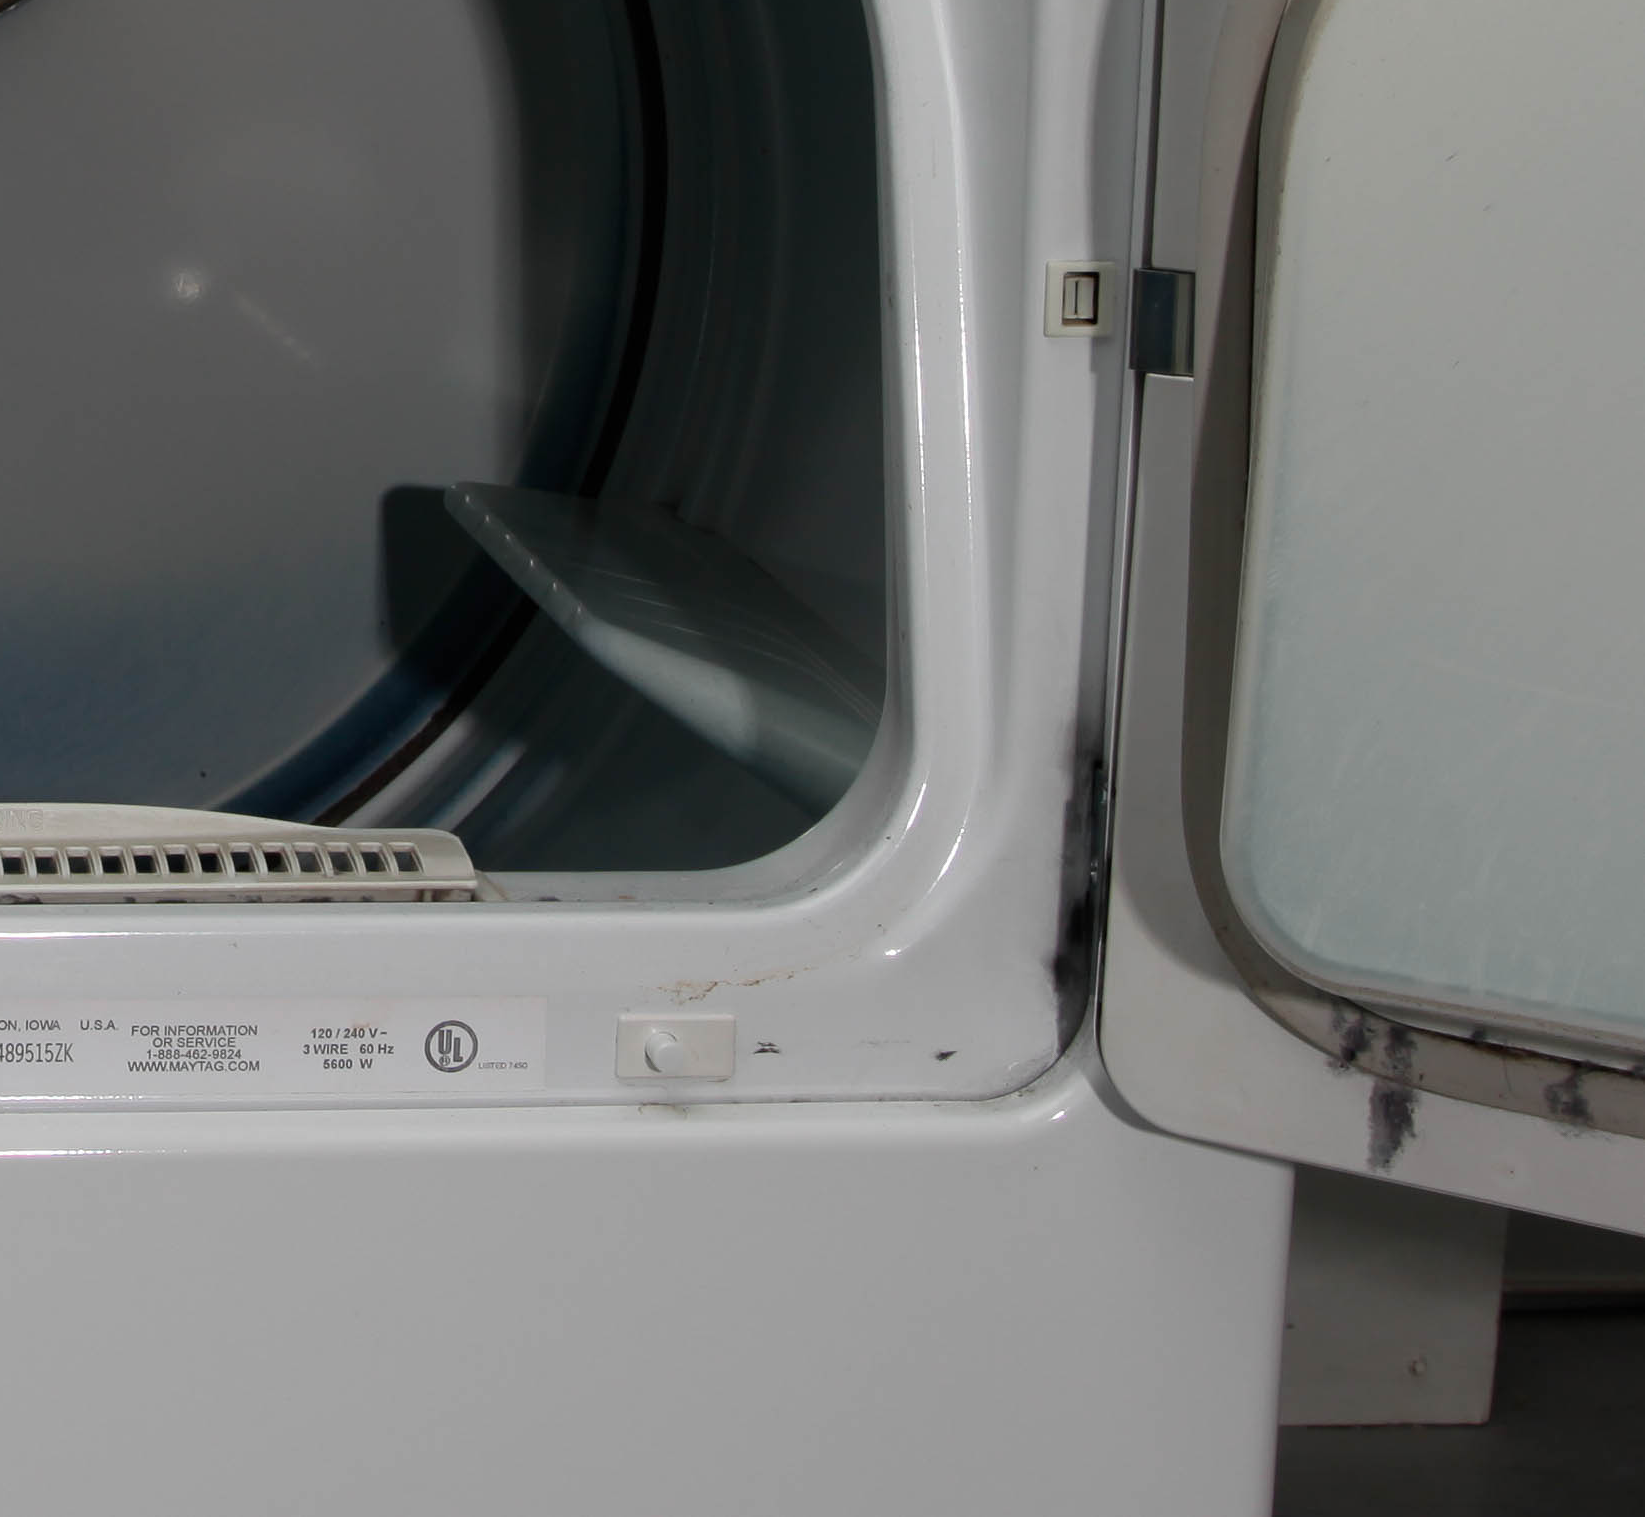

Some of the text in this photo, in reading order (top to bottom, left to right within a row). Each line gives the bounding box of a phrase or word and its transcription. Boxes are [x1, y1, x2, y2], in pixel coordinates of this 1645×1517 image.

[25, 1020, 61, 1032] IOWA
[79, 1020, 119, 1032] U.S.A.
[131, 1025, 258, 1036] FOR INFORMATION
[311, 1028, 333, 1039] 120
[343, 1028, 365, 1039] 240
[152, 1037, 236, 1048] OR SERVICE
[438, 1029, 464, 1063] UL
[146, 1049, 242, 1060] 1-888-462-9824
[303, 1043, 394, 1055] 3 WIRE 60 Hz
[127, 1060, 260, 1072] WWW.MAYTAG.COM
[323, 1058, 373, 1069] 5600 W
